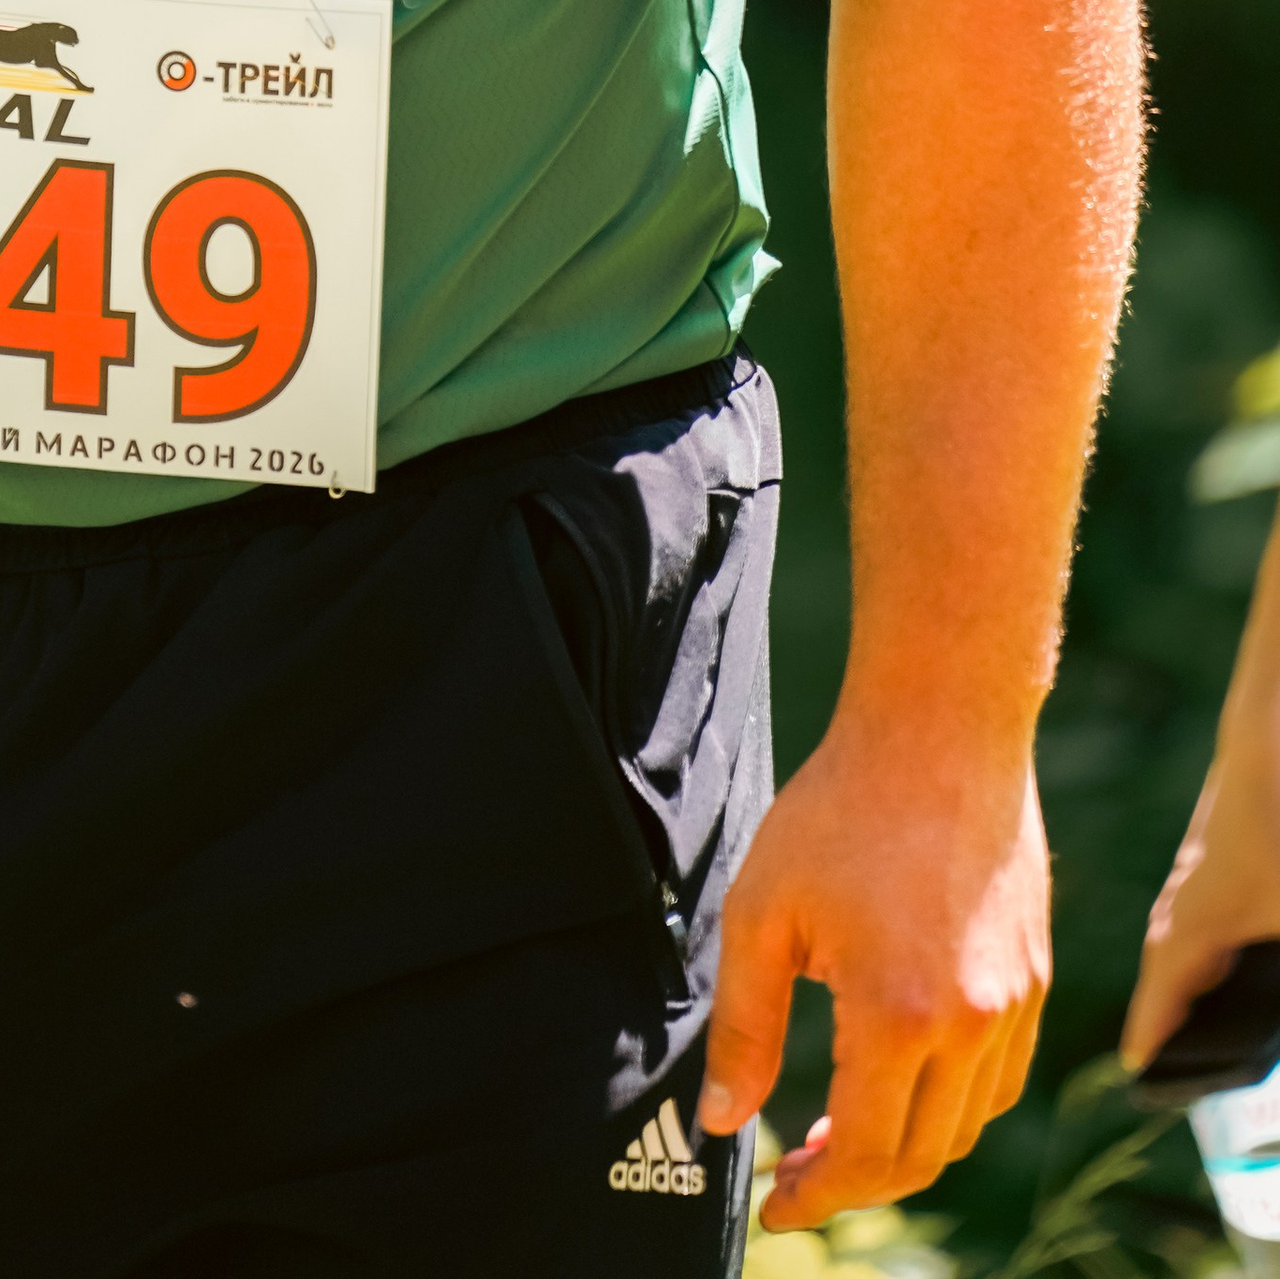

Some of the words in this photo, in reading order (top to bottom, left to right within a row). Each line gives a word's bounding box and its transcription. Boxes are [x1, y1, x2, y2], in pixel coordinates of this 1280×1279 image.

[35, 430, 236, 469] МАРАФОН
[249, 447, 326, 476] 2026
[608, 1158, 708, 1196] adidas
